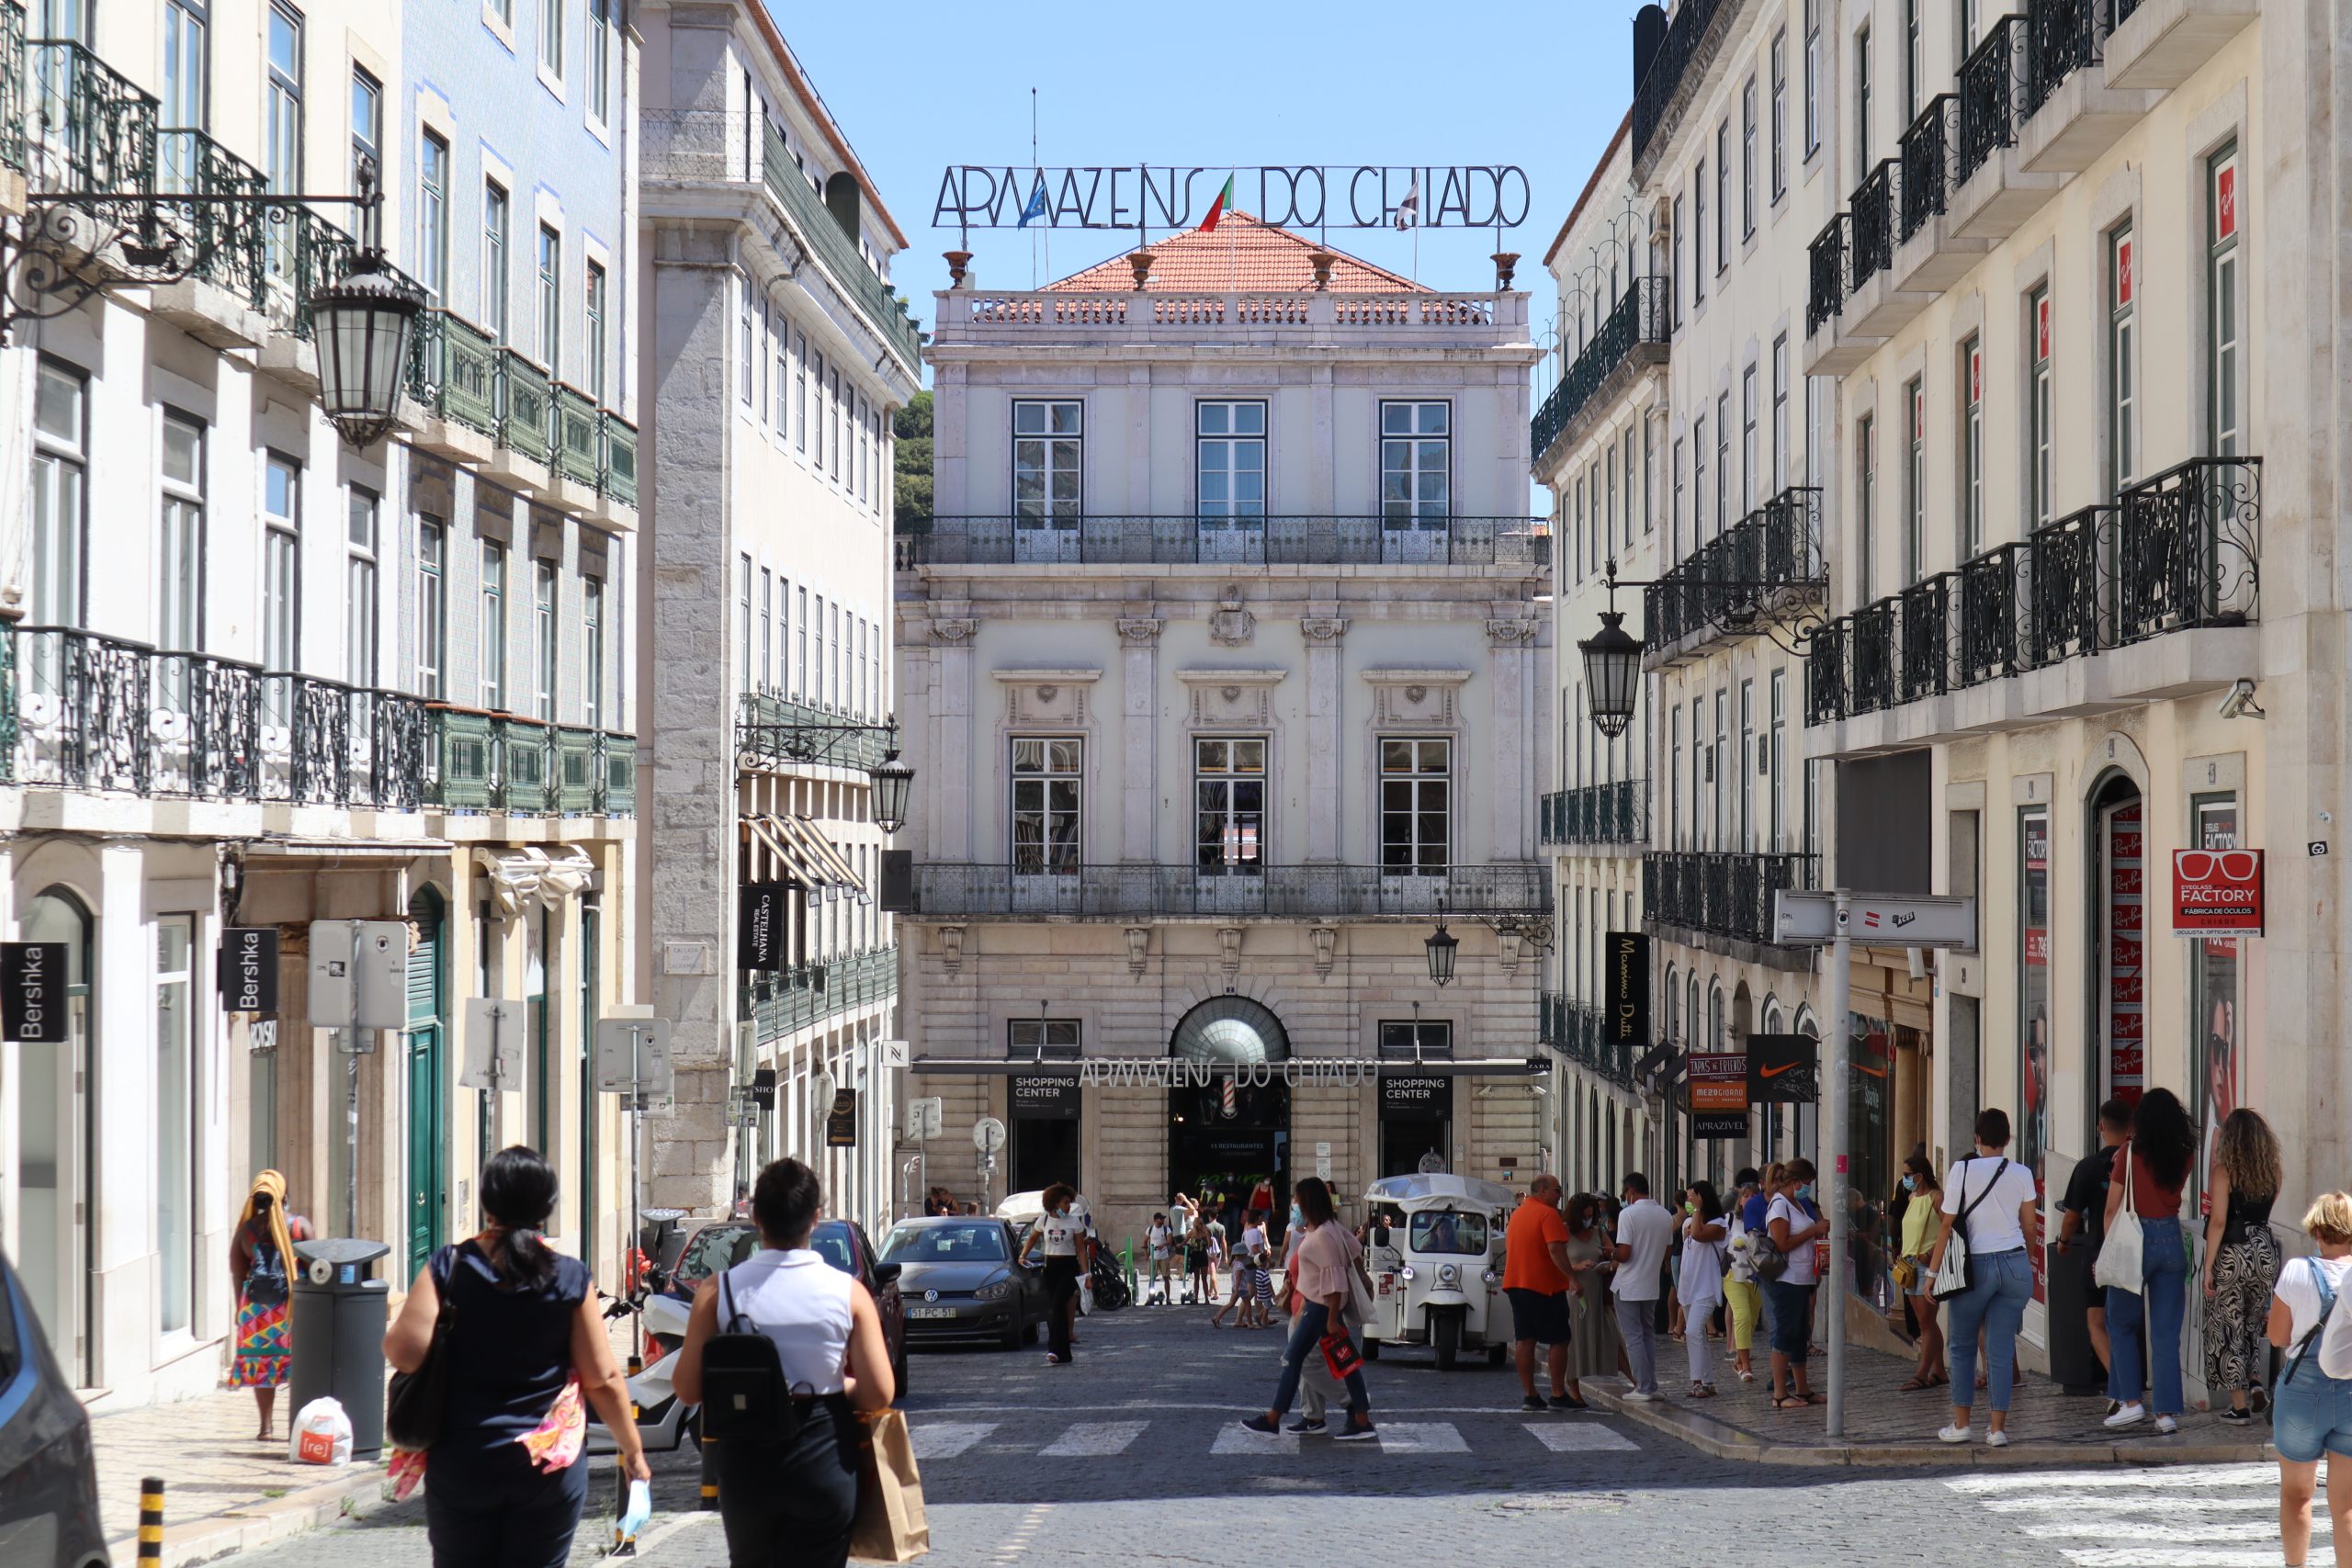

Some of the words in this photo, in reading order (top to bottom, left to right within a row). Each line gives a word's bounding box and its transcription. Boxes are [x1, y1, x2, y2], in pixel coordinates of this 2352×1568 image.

[932, 166, 1204, 228] ARMAZENS
[1261, 165, 1326, 228] DO
[1351, 165, 1530, 228] CHIADO
[2181, 889, 2255, 902] FACTORY
[2185, 907, 2213, 915] FÁBRICA
[2223, 907, 2252, 915] ÓCULOS
[758, 895, 771, 963] CASTELHANA
[240, 932, 259, 1009] Bershka
[1619, 938, 1635, 999] Massimo
[20, 947, 43, 1038] Bershka
[1619, 1002, 1635, 1040] Dutti
[1078, 1056, 1217, 1088] ARMAZENS
[1235, 1056, 1272, 1088] DO
[1283, 1056, 1378, 1088] CHIADO
[1720, 1058, 1747, 1073] FRIENDS
[1015, 1077, 1075, 1088] SHOPPING
[1015, 1088, 1060, 1098] CENTER
[1385, 1078, 1445, 1089] SHOPPING
[1385, 1089, 1430, 1099] CENTER
